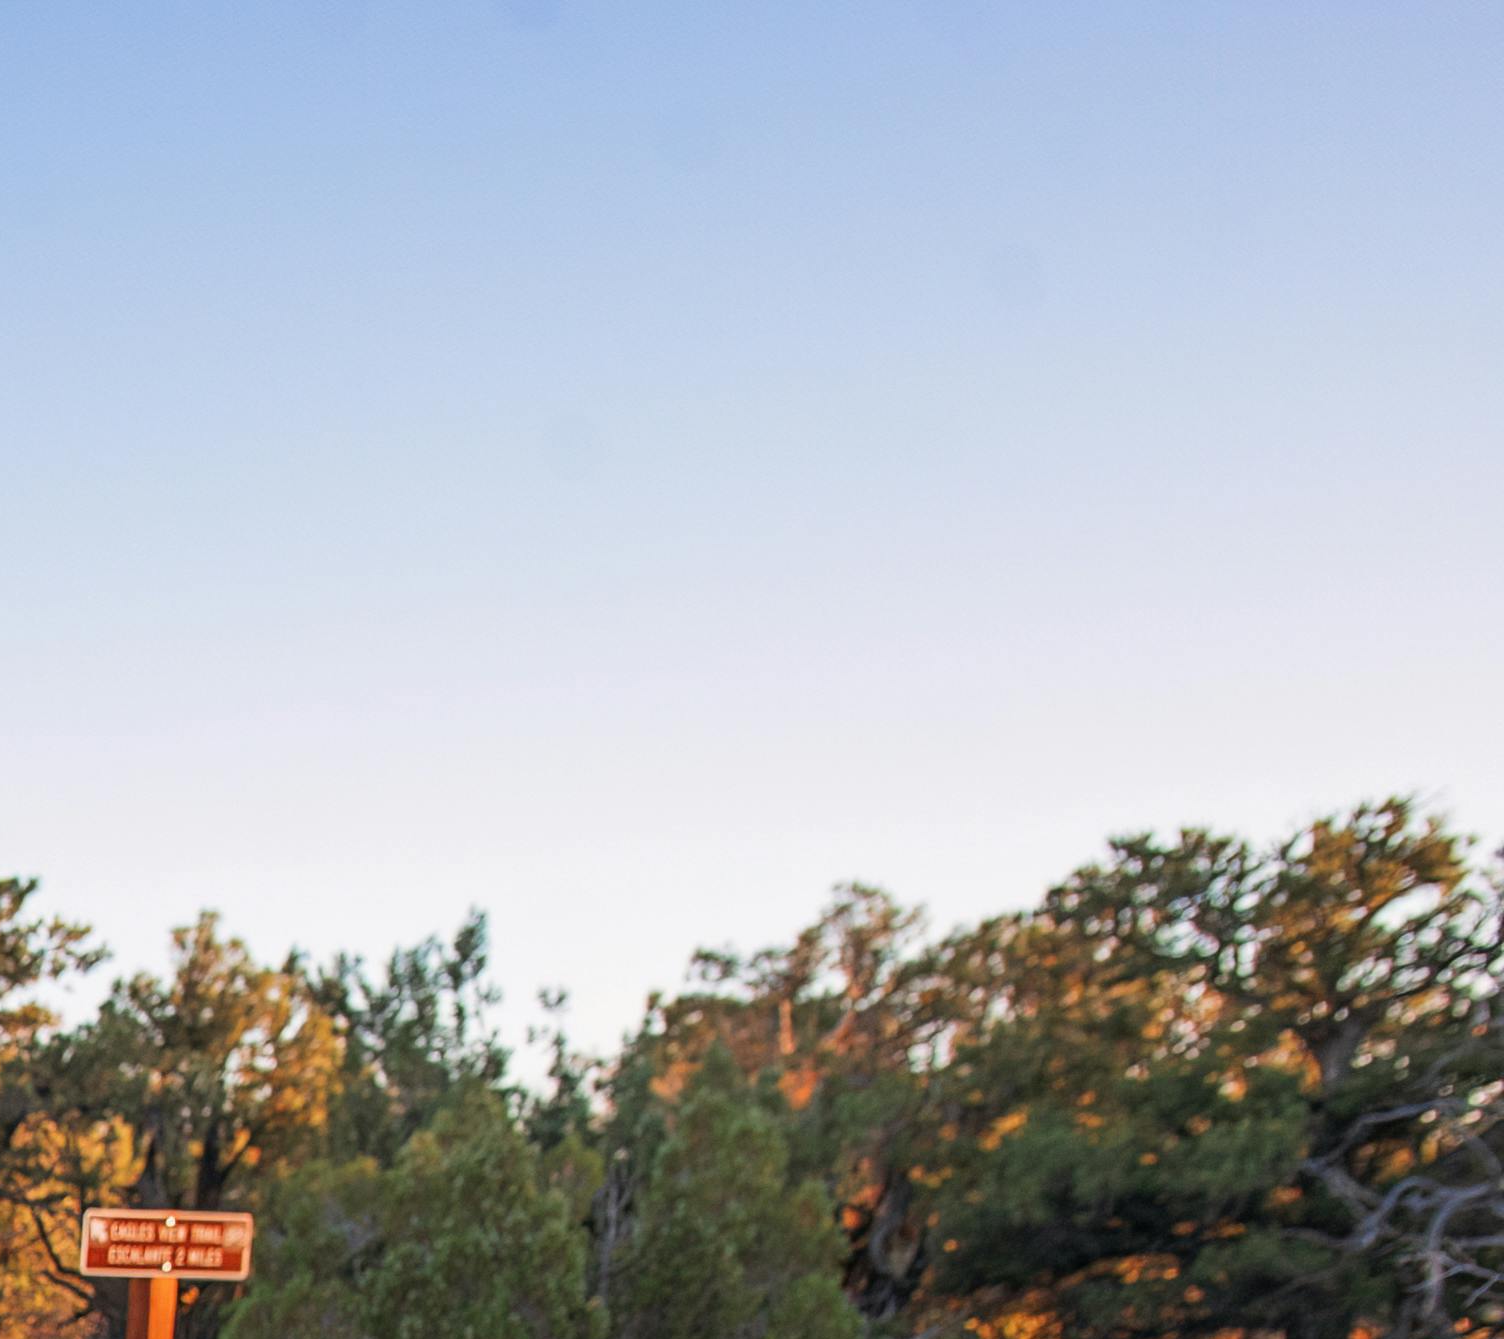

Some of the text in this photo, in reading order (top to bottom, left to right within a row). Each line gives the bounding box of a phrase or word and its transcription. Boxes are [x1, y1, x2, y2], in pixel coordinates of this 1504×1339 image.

[190, 1223, 224, 1245] TRAIL
[108, 1244, 223, 1267] ESCALANTE 2 MILES
